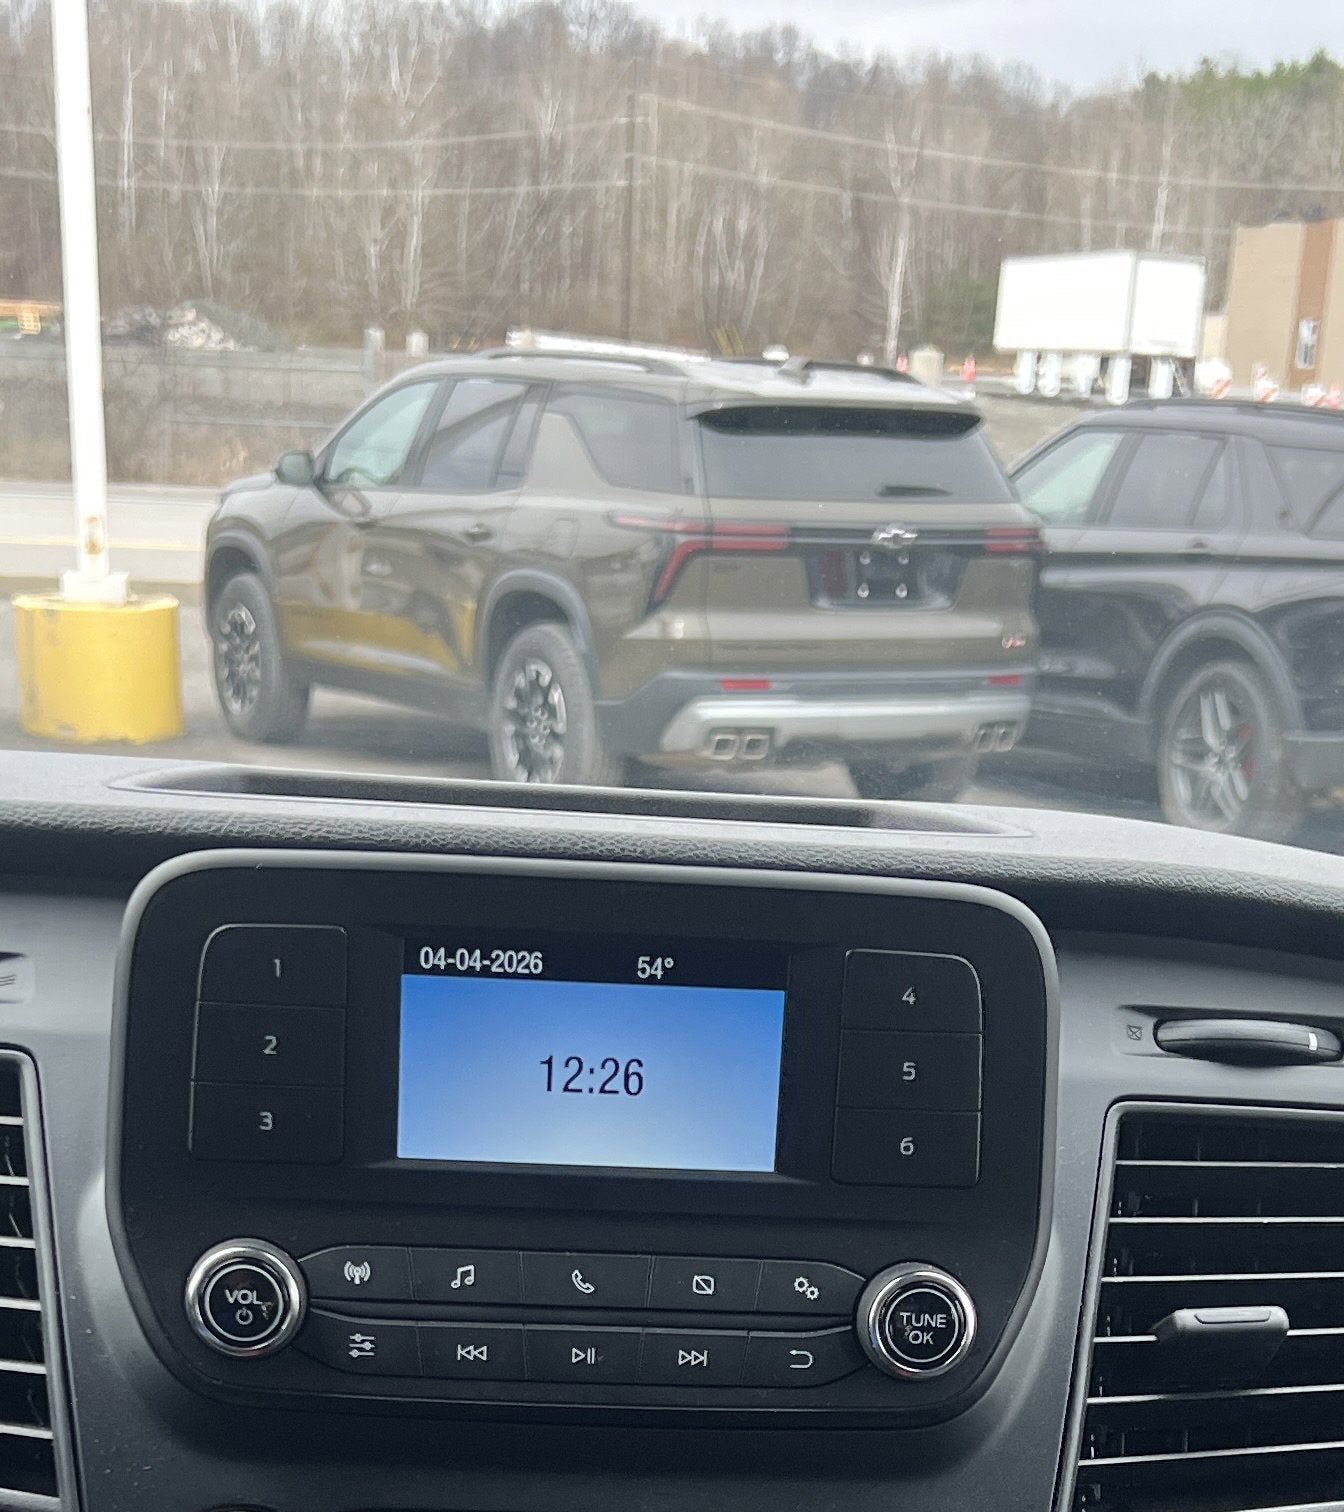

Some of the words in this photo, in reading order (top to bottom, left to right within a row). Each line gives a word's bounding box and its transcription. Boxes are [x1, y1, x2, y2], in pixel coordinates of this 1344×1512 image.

[272, 958, 282, 978] 1
[419, 946, 544, 975] 04-04-2026
[637, 956, 674, 980] 54°
[901, 986, 917, 1006] 4
[262, 1035, 277, 1055] 2
[539, 1055, 645, 1097] 12:26
[902, 1061, 917, 1081] 5
[258, 1111, 273, 1131] 3
[899, 1136, 914, 1156] 6
[225, 1289, 262, 1304] VOL
[899, 1311, 947, 1328] TUNE
[908, 1330, 934, 1345] OK
